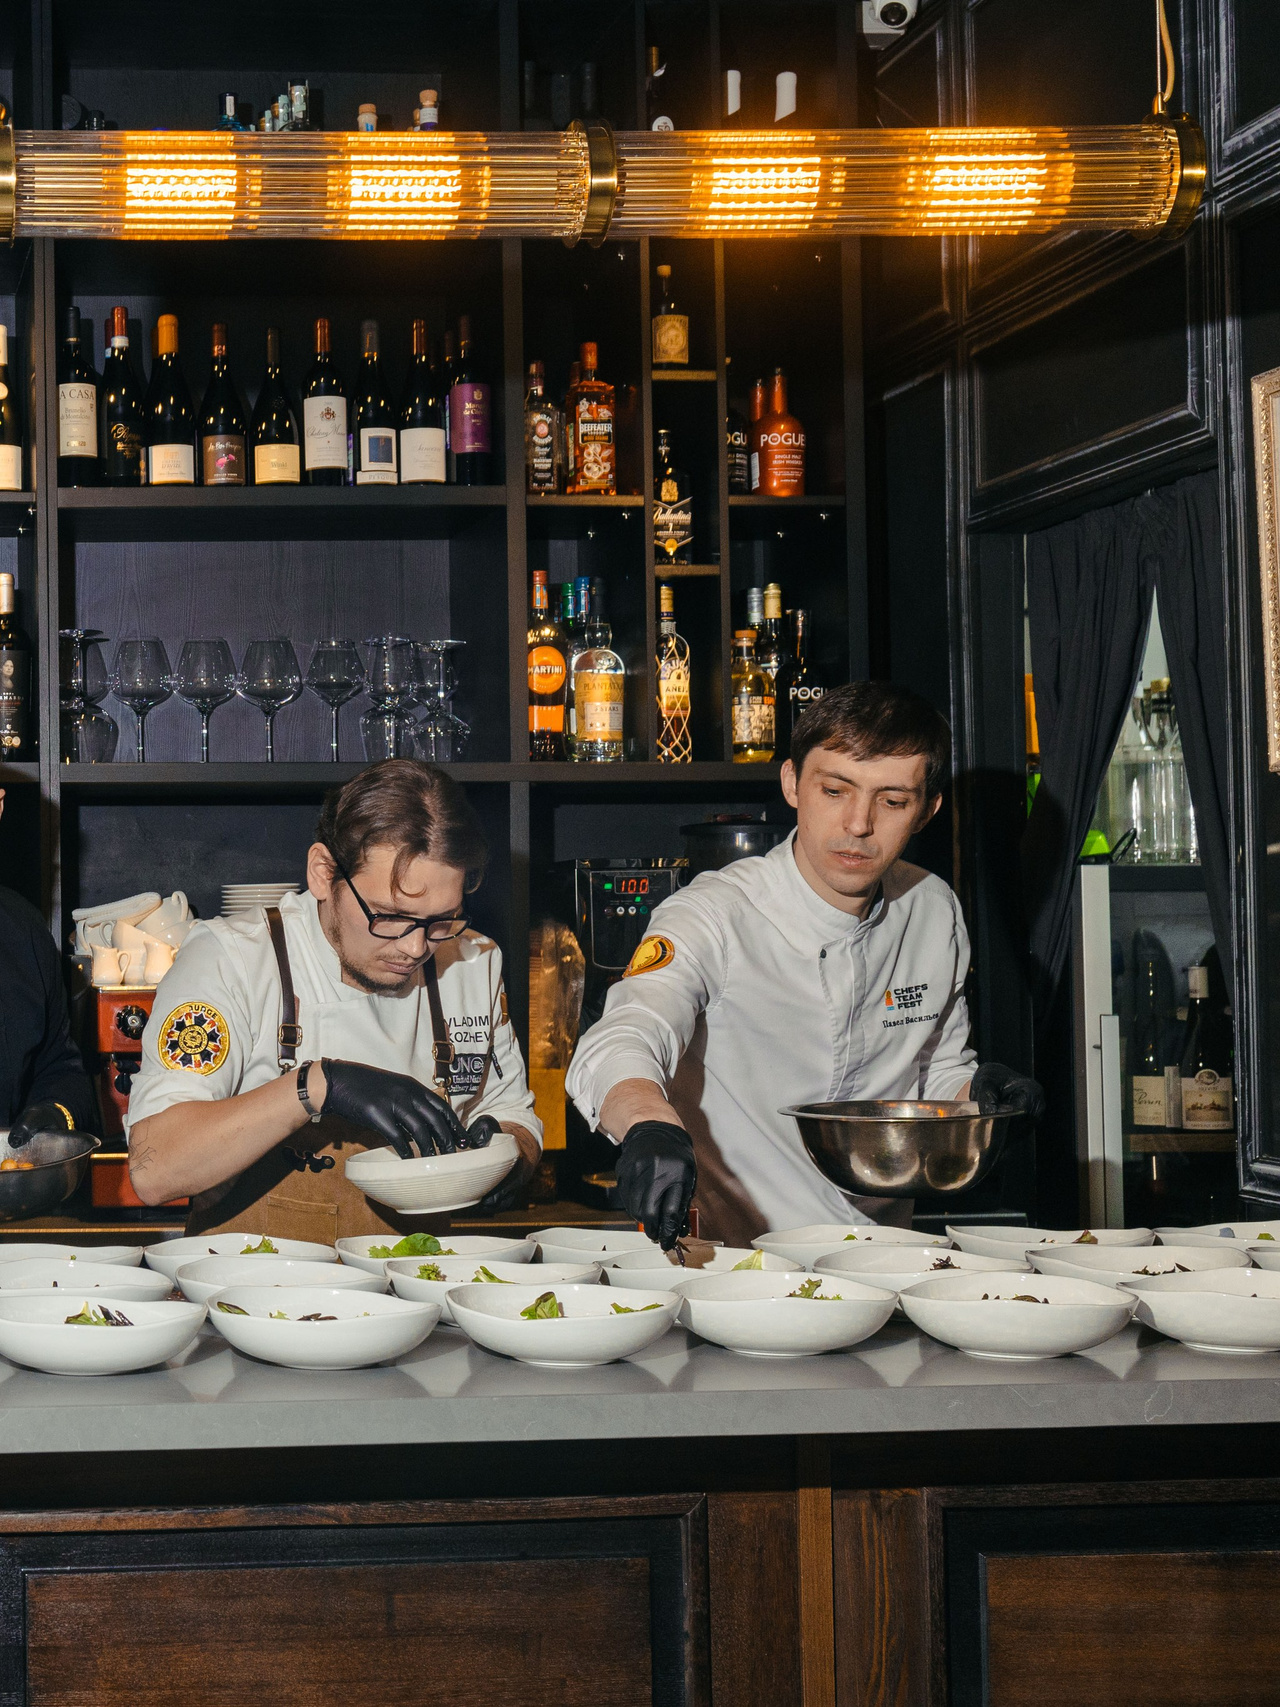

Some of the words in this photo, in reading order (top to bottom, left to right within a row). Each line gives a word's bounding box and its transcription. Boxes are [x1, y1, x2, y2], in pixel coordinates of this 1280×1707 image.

[68, 389, 95, 400] CASA
[580, 423, 612, 433] BEEFEATER
[653, 506, 692, 521] Ballantine's
[528, 665, 563, 675] MARTINI
[665, 684, 688, 693] AÑEJ
[621, 878, 649, 894] 100
[893, 983, 928, 996] CHEFS
[895, 992, 923, 1002] TEAM
[897, 999, 923, 1010] FEST
[188, 1004, 218, 1020] JUDGE
[882, 1019, 905, 1028] Павел
[452, 1075, 470, 1084] United
